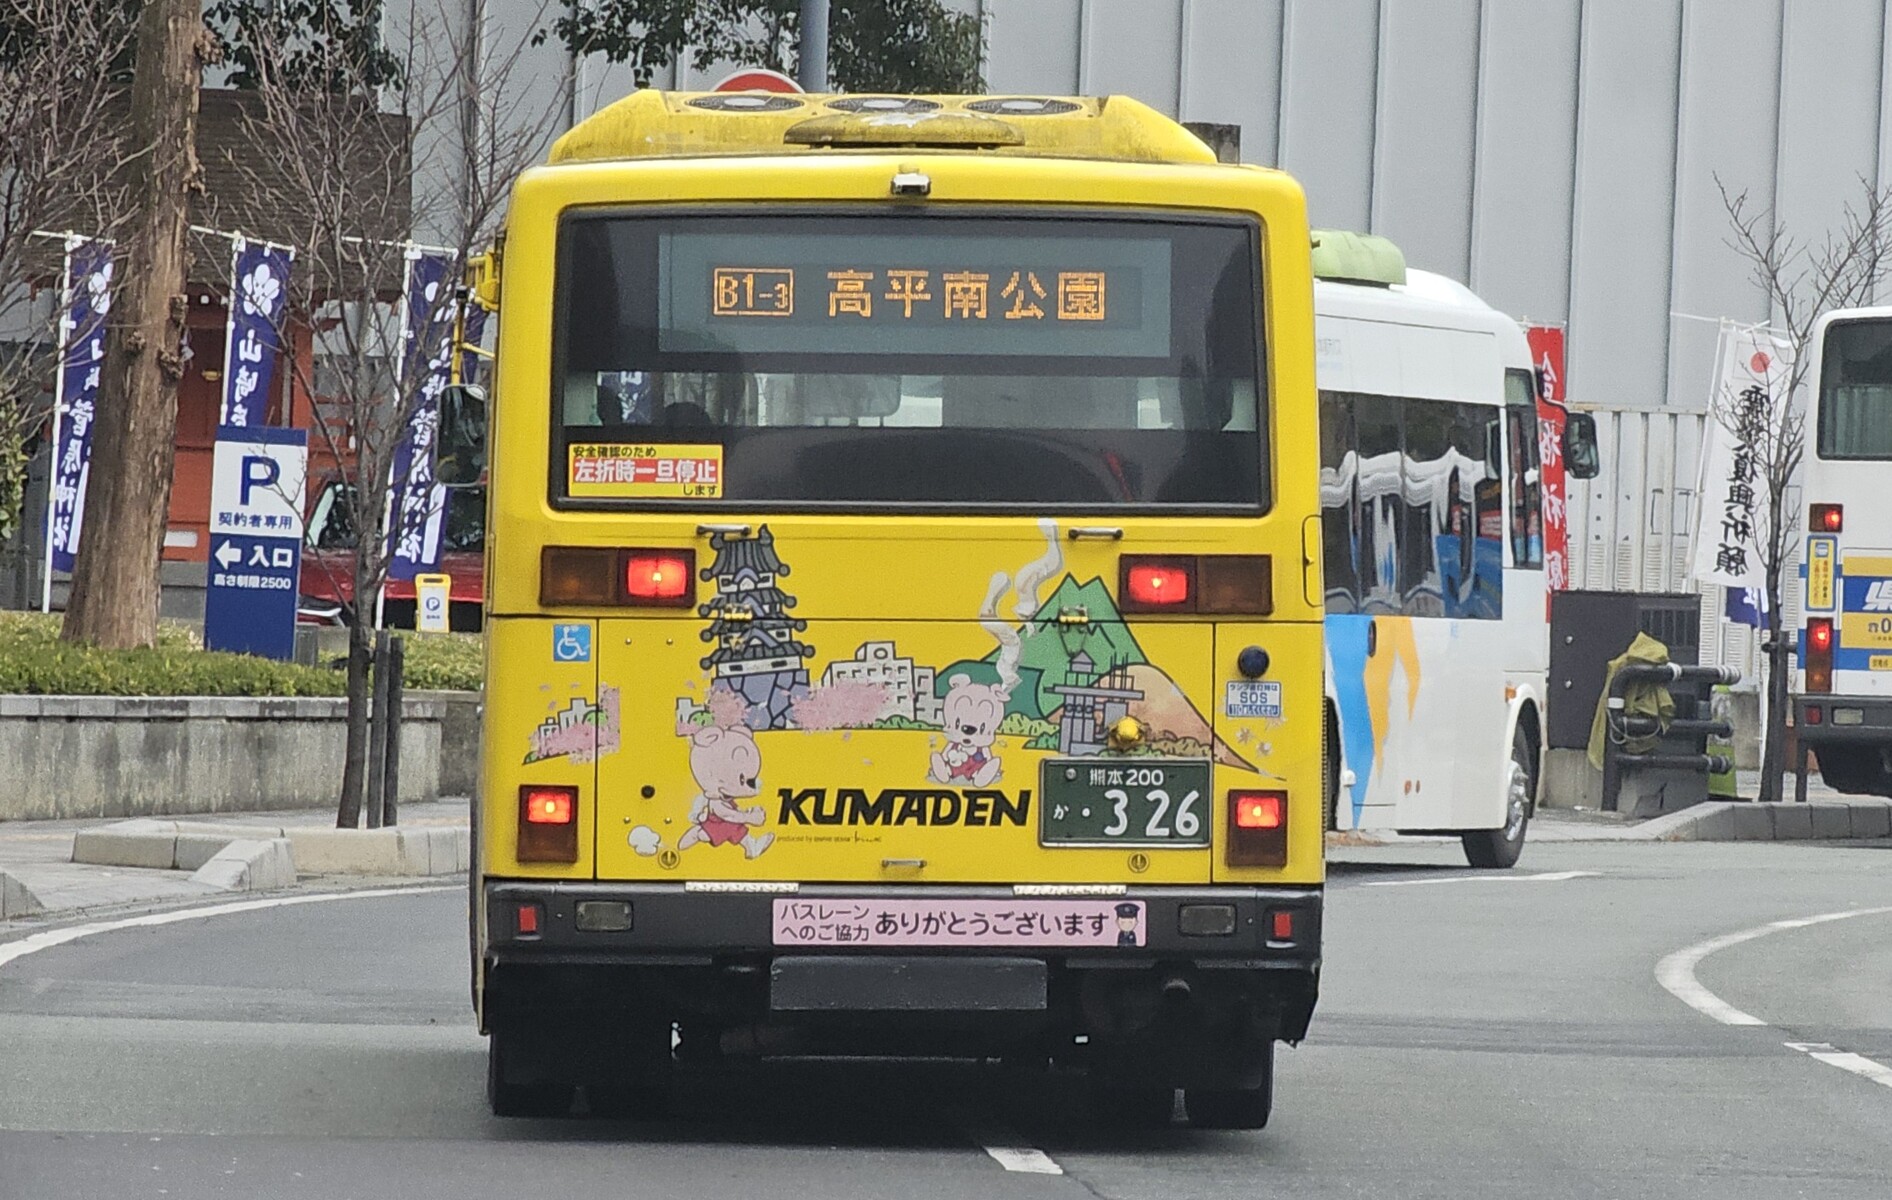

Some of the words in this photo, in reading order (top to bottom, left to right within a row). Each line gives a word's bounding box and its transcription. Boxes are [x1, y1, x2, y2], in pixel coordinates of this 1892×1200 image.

[718, 273, 789, 309] B1-3
[826, 269, 1105, 320] 高平南公園
[573, 446, 657, 458] 安全確認のため
[240, 455, 280, 506] P
[574, 458, 717, 484] 左折時一旦停止
[683, 484, 717, 496] します
[218, 511, 293, 530] 契約者専用
[248, 545, 294, 568] 入口
[1240, 691, 1268, 704] SOS
[777, 788, 1032, 826] KUMADEN
[1053, 803, 1070, 820] か
[780, 903, 870, 921] バスレーン
[780, 923, 870, 942] へのご協力
[875, 910, 1110, 937] ありがとうございます
